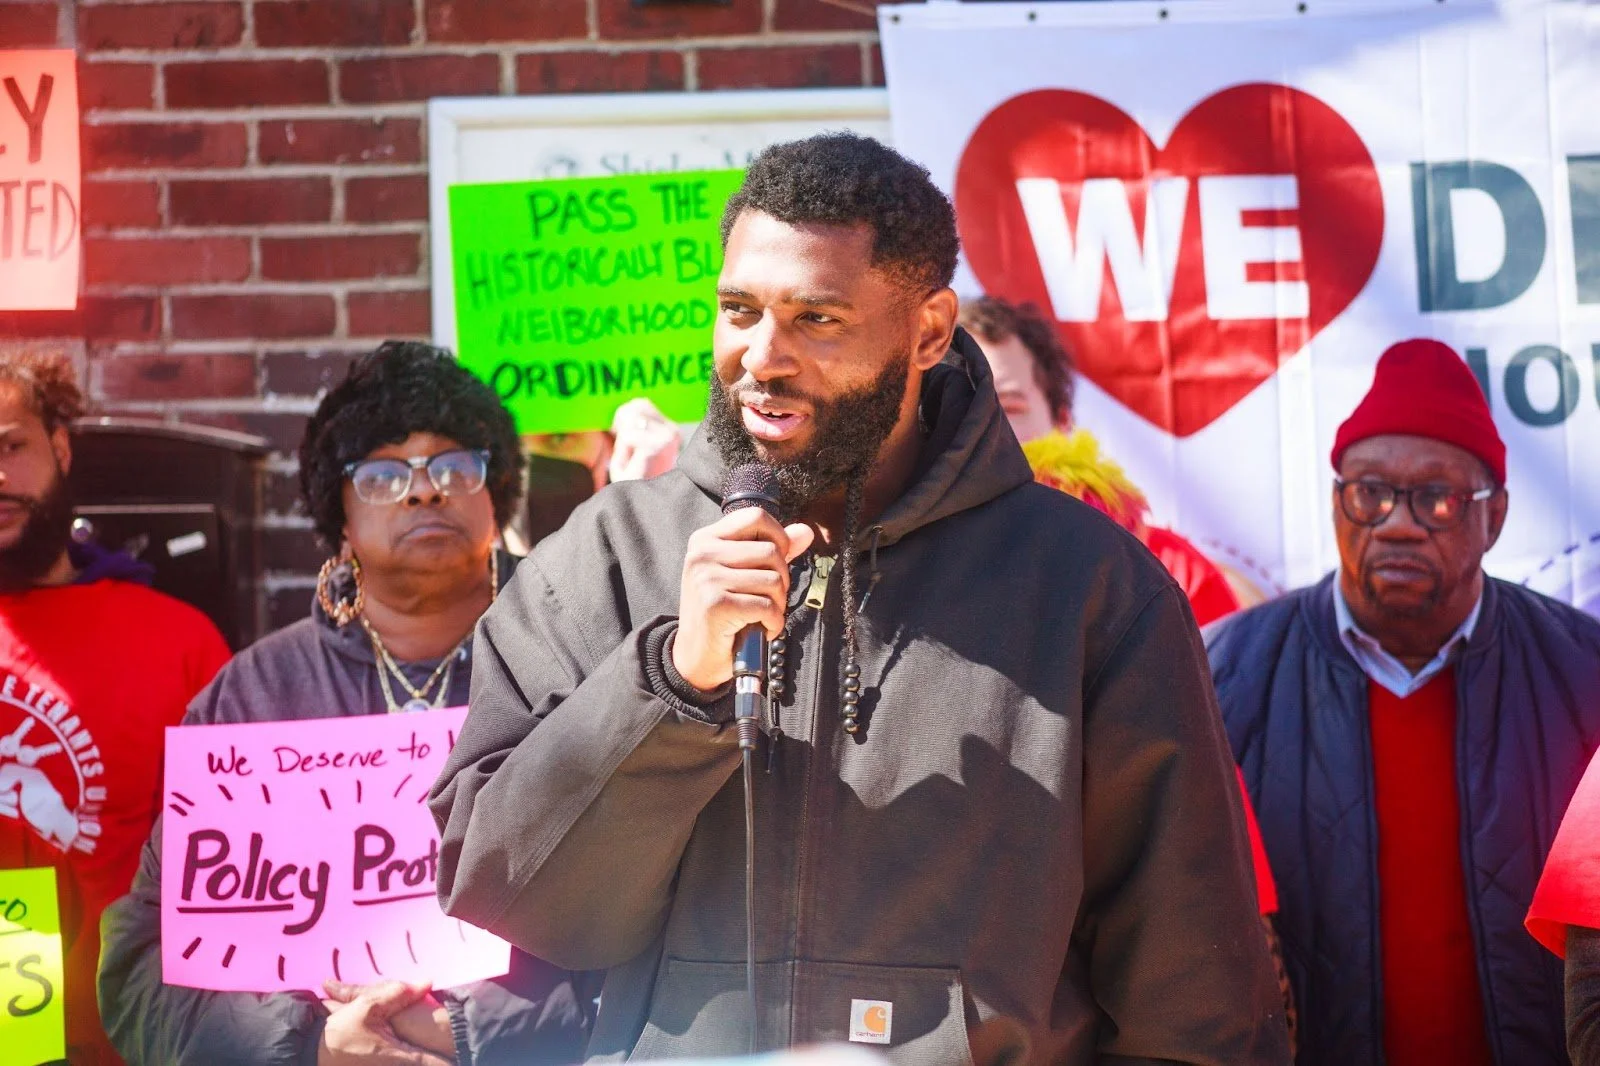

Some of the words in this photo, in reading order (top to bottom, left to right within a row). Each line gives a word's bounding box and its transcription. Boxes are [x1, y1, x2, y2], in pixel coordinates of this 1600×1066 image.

[0, 74, 54, 164] Y
[528, 189, 637, 240] PASS
[651, 181, 712, 224] THE
[1016, 174, 1309, 322] WE
[496, 298, 713, 347] NEIBORHOOD
[489, 351, 714, 401] ORDINANCE
[25, 682, 105, 778] TENANTS
[207, 745, 253, 776] We
[273, 746, 388, 772] Deserve
[397, 731, 431, 759] to
[181, 828, 330, 936] Policy
[353, 824, 440, 892] Prot
